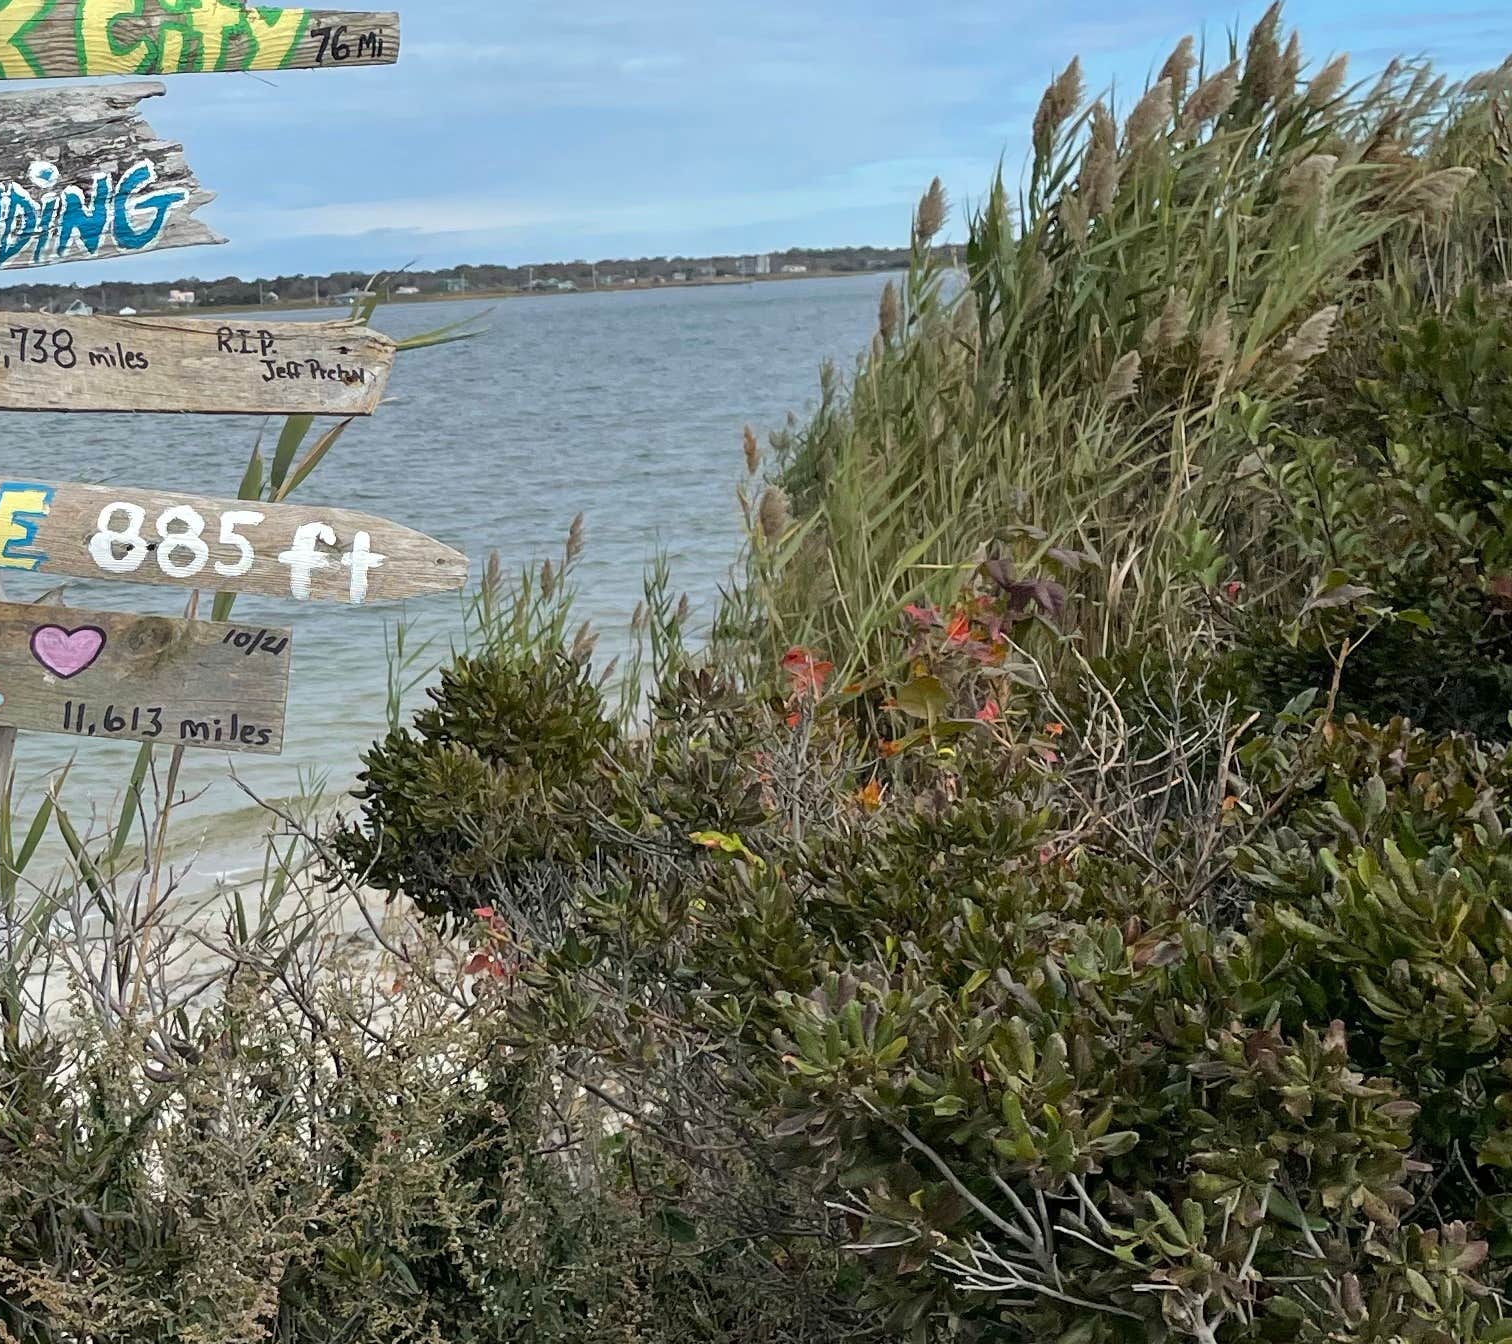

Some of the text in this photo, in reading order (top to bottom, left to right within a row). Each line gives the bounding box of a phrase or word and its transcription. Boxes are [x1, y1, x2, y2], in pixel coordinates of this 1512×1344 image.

[311, 26, 352, 64] 76
[88, 342, 149, 370] miles
[260, 359, 304, 383] Jeff
[88, 500, 267, 579] 885
[277, 520, 387, 605] ft
[62, 699, 274, 746] 11,613 miles
